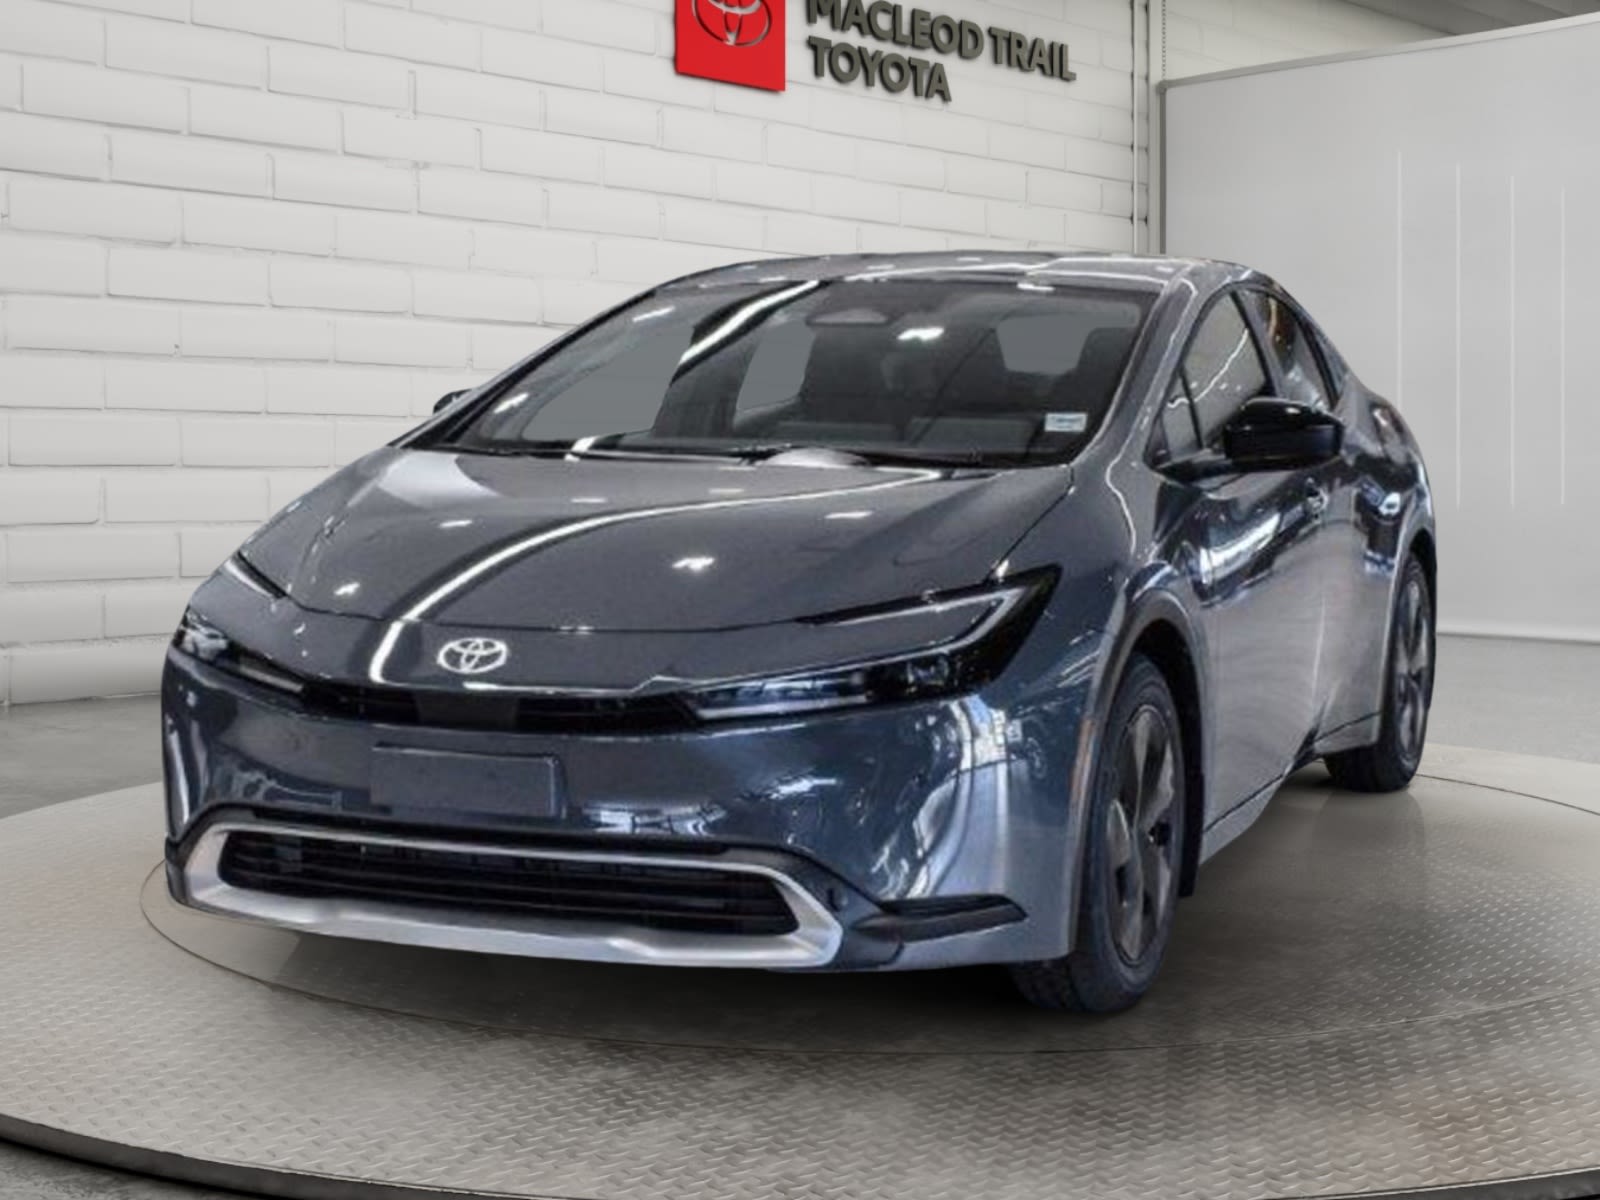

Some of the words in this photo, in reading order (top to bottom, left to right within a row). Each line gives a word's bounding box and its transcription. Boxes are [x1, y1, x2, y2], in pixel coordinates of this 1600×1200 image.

[806, 0, 984, 59] MACLEOD
[988, 26, 1076, 81] TRAIL
[808, 36, 951, 102] TOYOTA
